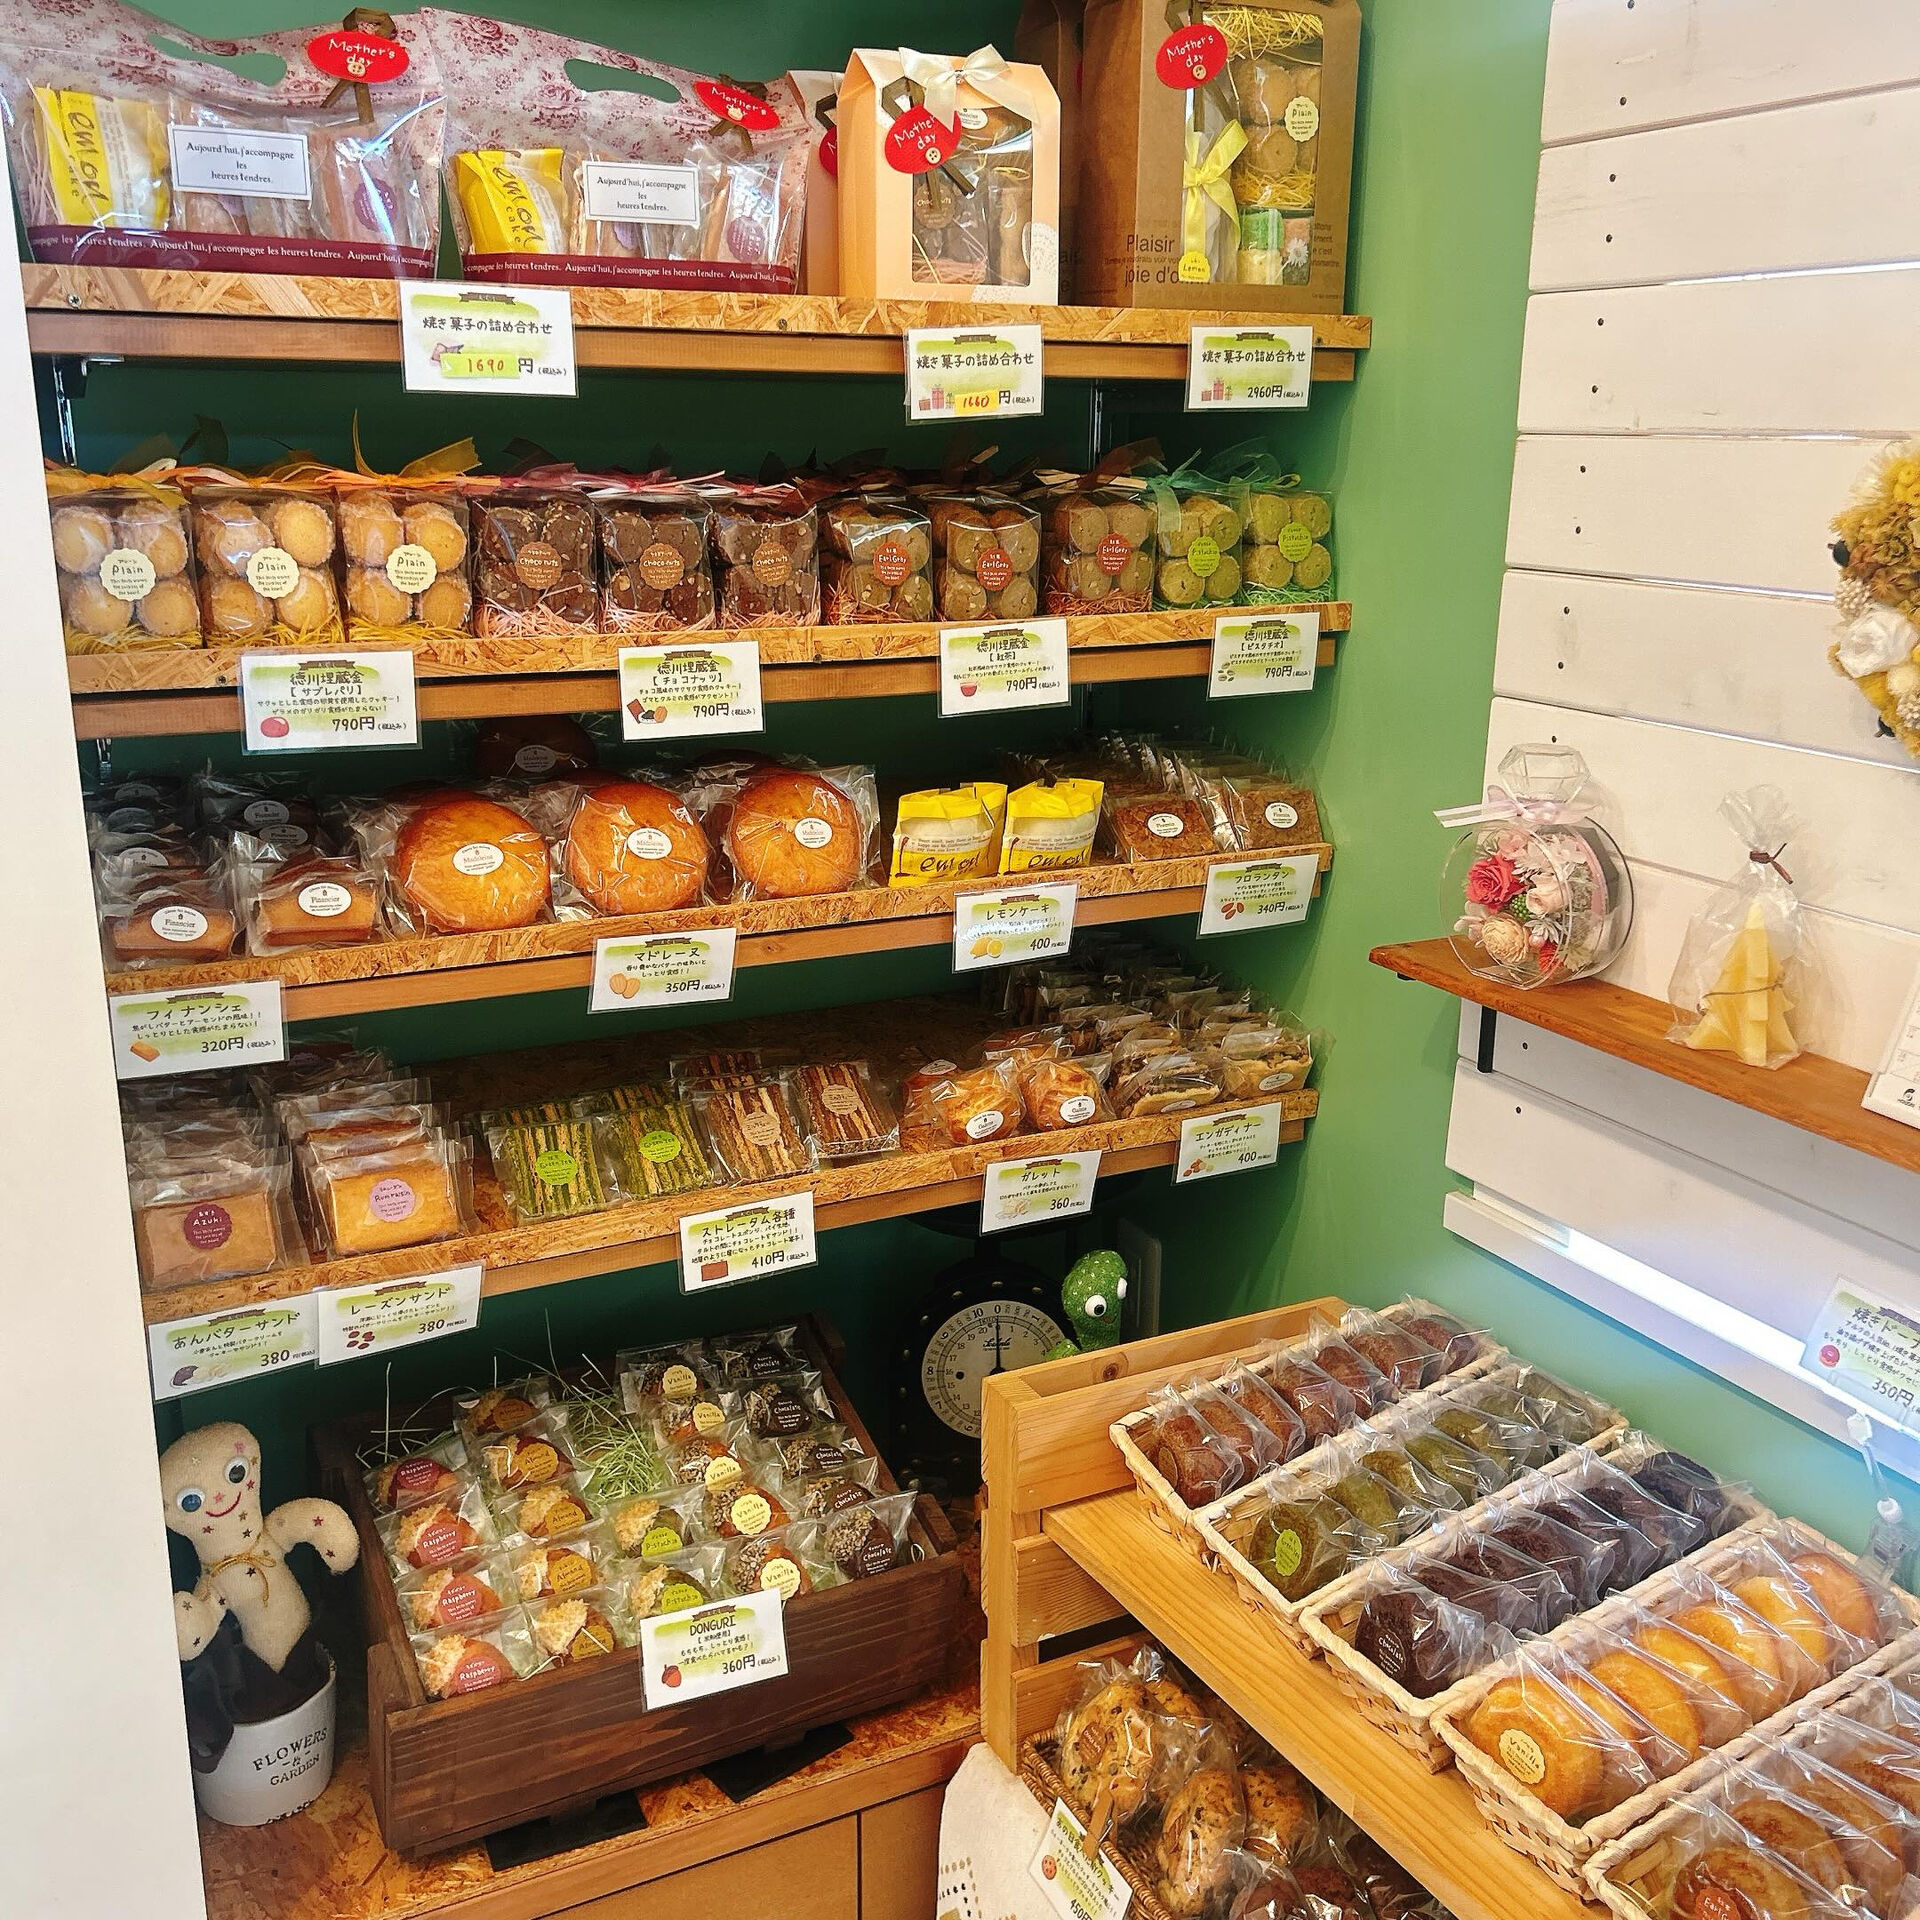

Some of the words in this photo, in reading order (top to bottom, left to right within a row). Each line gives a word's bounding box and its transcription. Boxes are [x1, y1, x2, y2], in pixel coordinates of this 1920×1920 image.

[329, 38, 396, 59] Mother's
[1166, 34, 1214, 63] Mother's
[346, 53, 374, 68] day
[1185, 54, 1204, 68] day
[711, 87, 767, 116] Mother's
[894, 114, 936, 149] Mother
[917, 133, 936, 150] day
[236, 160, 248, 170] les
[210, 170, 239, 182] heures
[638, 192, 647, 200] les
[617, 201, 640, 210] heures
[61, 234, 74, 244] les
[267, 245, 280, 256] les
[281, 247, 309, 258] heures
[1126, 233, 1176, 253] Plaisir
[505, 262, 529, 271] heures
[662, 267, 672, 276] les
[673, 267, 697, 277] heures
[1124, 265, 1150, 288] joie
[423, 316, 553, 335] 焼き菓子の詰め合わせ
[916, 352, 1034, 370] 焼き菓子の詰め合わせ
[1202, 349, 1306, 364] 焼き菓子の詰め合わせ
[468, 358, 505, 373] 1690
[518, 357, 534, 374] 円
[999, 390, 1011, 405] 円
[1247, 385, 1283, 399] 2960円
[257, 561, 287, 573] Plain
[397, 556, 425, 567] Plain
[112, 564, 144, 576] Plain
[976, 637, 1030, 653] 徳川埋蔵金
[657, 660, 720, 675] 徳川埋蔵金
[1265, 665, 1293, 679] 790円
[289, 670, 365, 687] 徳川埋蔵金
[1006, 676, 1037, 692] 790円
[693, 703, 729, 718] 790円
[332, 716, 375, 732] 790円
[1235, 870, 1289, 884] フロランタン
[986, 903, 1050, 921] レモンケーキ
[1257, 901, 1286, 914] 340円
[1030, 937, 1051, 951] 400
[634, 947, 701, 962] マドレーヌ
[665, 979, 700, 994] 350円
[146, 1002, 242, 1021] フィナンシェ
[201, 1037, 244, 1053] 320円
[1195, 1122, 1262, 1142] エンガディナー
[1238, 1151, 1257, 1164] 400
[1021, 1167, 1060, 1182] ガレット
[1050, 1197, 1070, 1210] 360
[193, 1217, 222, 1227] Azuki
[702, 1207, 796, 1238] ストレータム各種
[752, 1250, 785, 1268] 410円
[350, 1287, 451, 1316] レーズンサンド
[172, 1312, 301, 1350] あんバターサンド
[418, 1319, 445, 1334] 380
[260, 1349, 290, 1367] 380
[1871, 1377, 1915, 1408] 350円
[774, 1403, 801, 1414] Chocolate
[709, 1464, 738, 1481] Vanilla
[422, 1530, 457, 1549] Raspberry
[862, 1545, 893, 1562] Chocolate
[765, 1569, 794, 1584] Vanilla
[441, 1588, 477, 1606] Raspberry
[689, 1614, 737, 1637] DONGURI
[459, 1664, 496, 1681] Raspberry
[722, 1654, 755, 1675] 360円
[253, 1727, 327, 1771] FLOWERS
[270, 1753, 320, 1786] GARDEN
